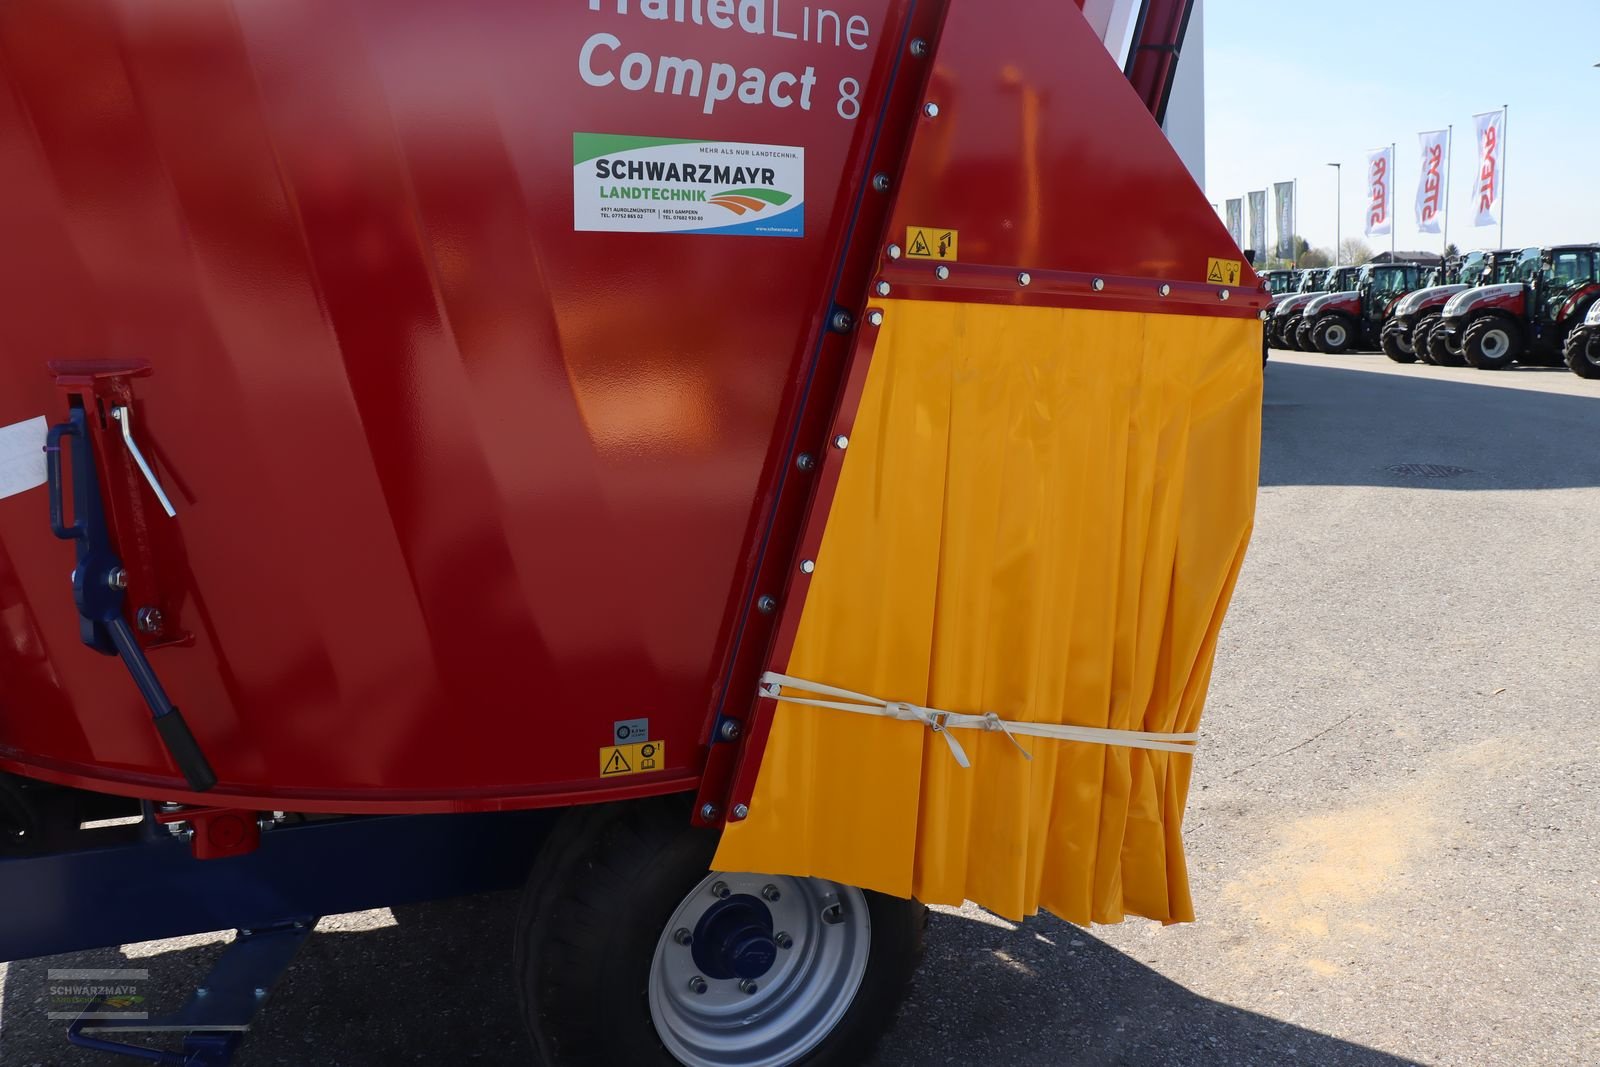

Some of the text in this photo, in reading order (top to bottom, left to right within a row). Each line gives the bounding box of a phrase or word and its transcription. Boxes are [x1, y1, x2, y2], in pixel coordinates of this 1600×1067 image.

[588, 0, 870, 50] aledLine
[578, 32, 861, 120] Compact 8
[751, 150, 799, 159] LANDTECHNIK.
[595, 158, 775, 186] SCHWARZMAYR
[600, 185, 707, 202] LANDTECHNIK
